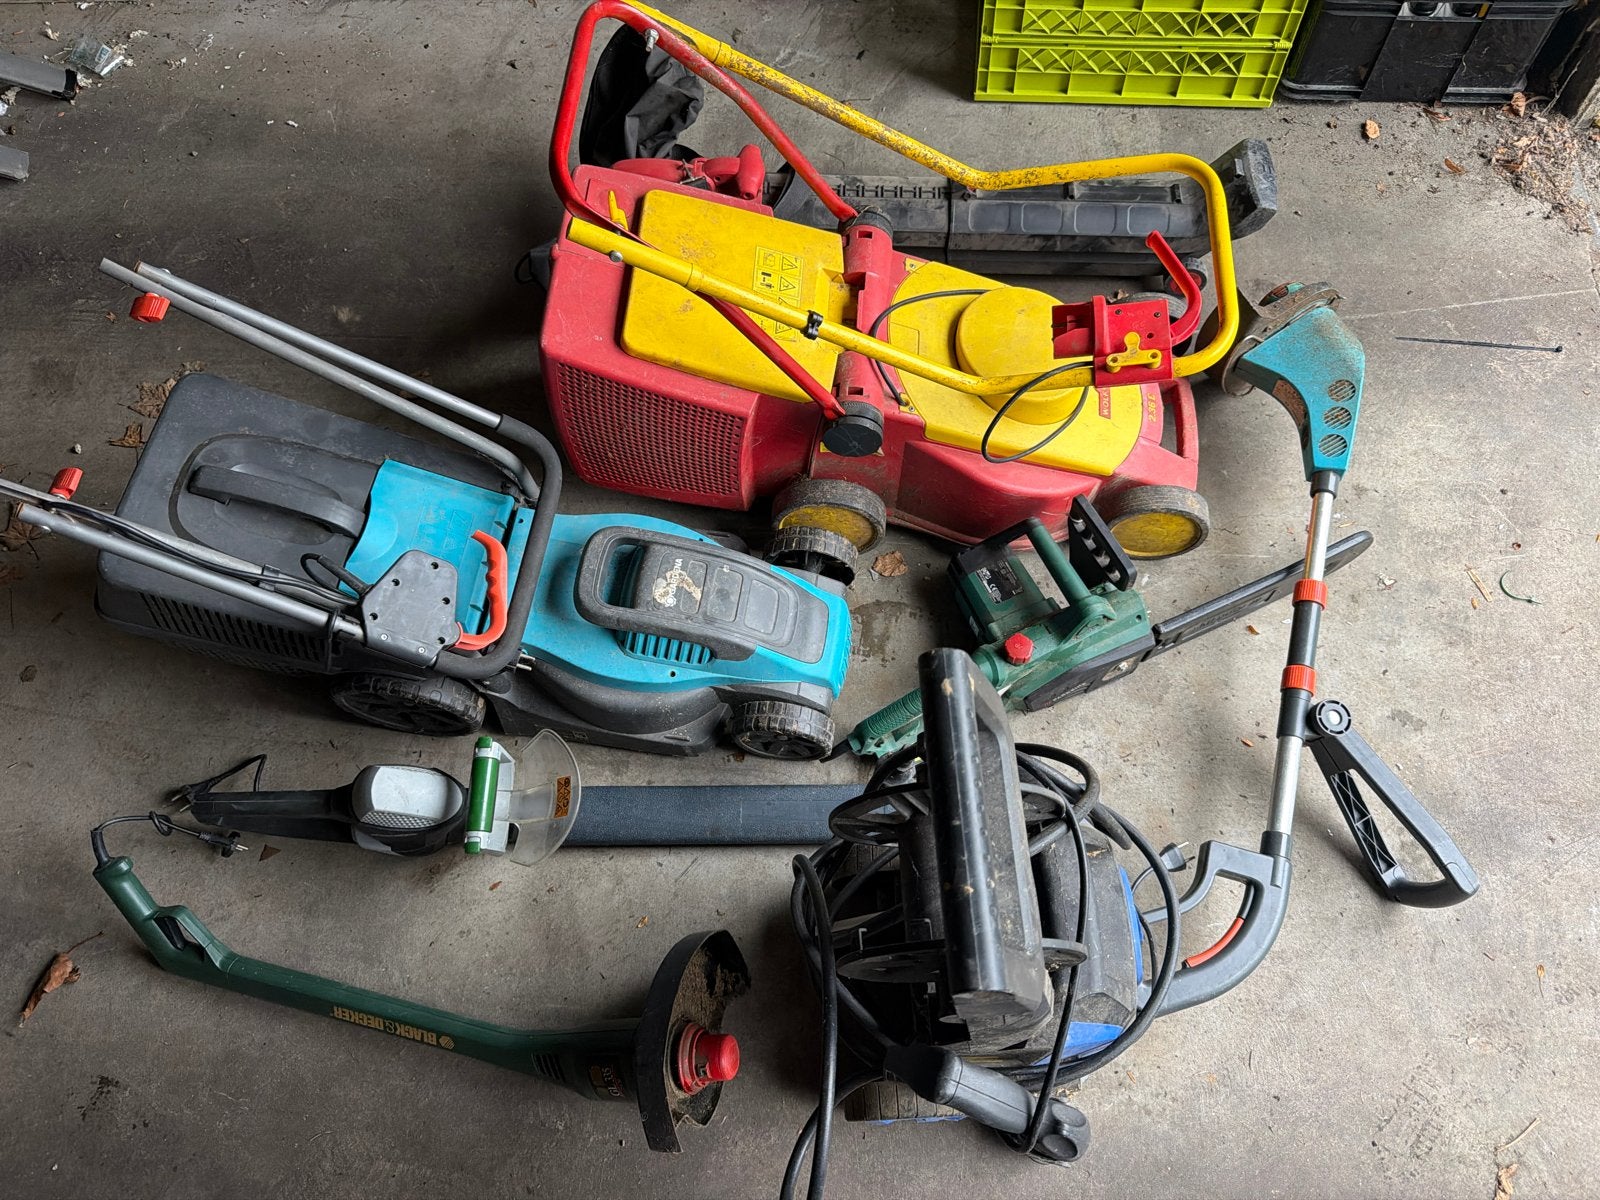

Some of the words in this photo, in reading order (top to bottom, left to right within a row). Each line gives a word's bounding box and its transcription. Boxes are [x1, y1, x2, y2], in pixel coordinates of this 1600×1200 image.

[1147, 400, 1157, 422] 2.36
[671, 558, 683, 595] GARDENA
[332, 1005, 437, 1046] BLACK&DECKER
